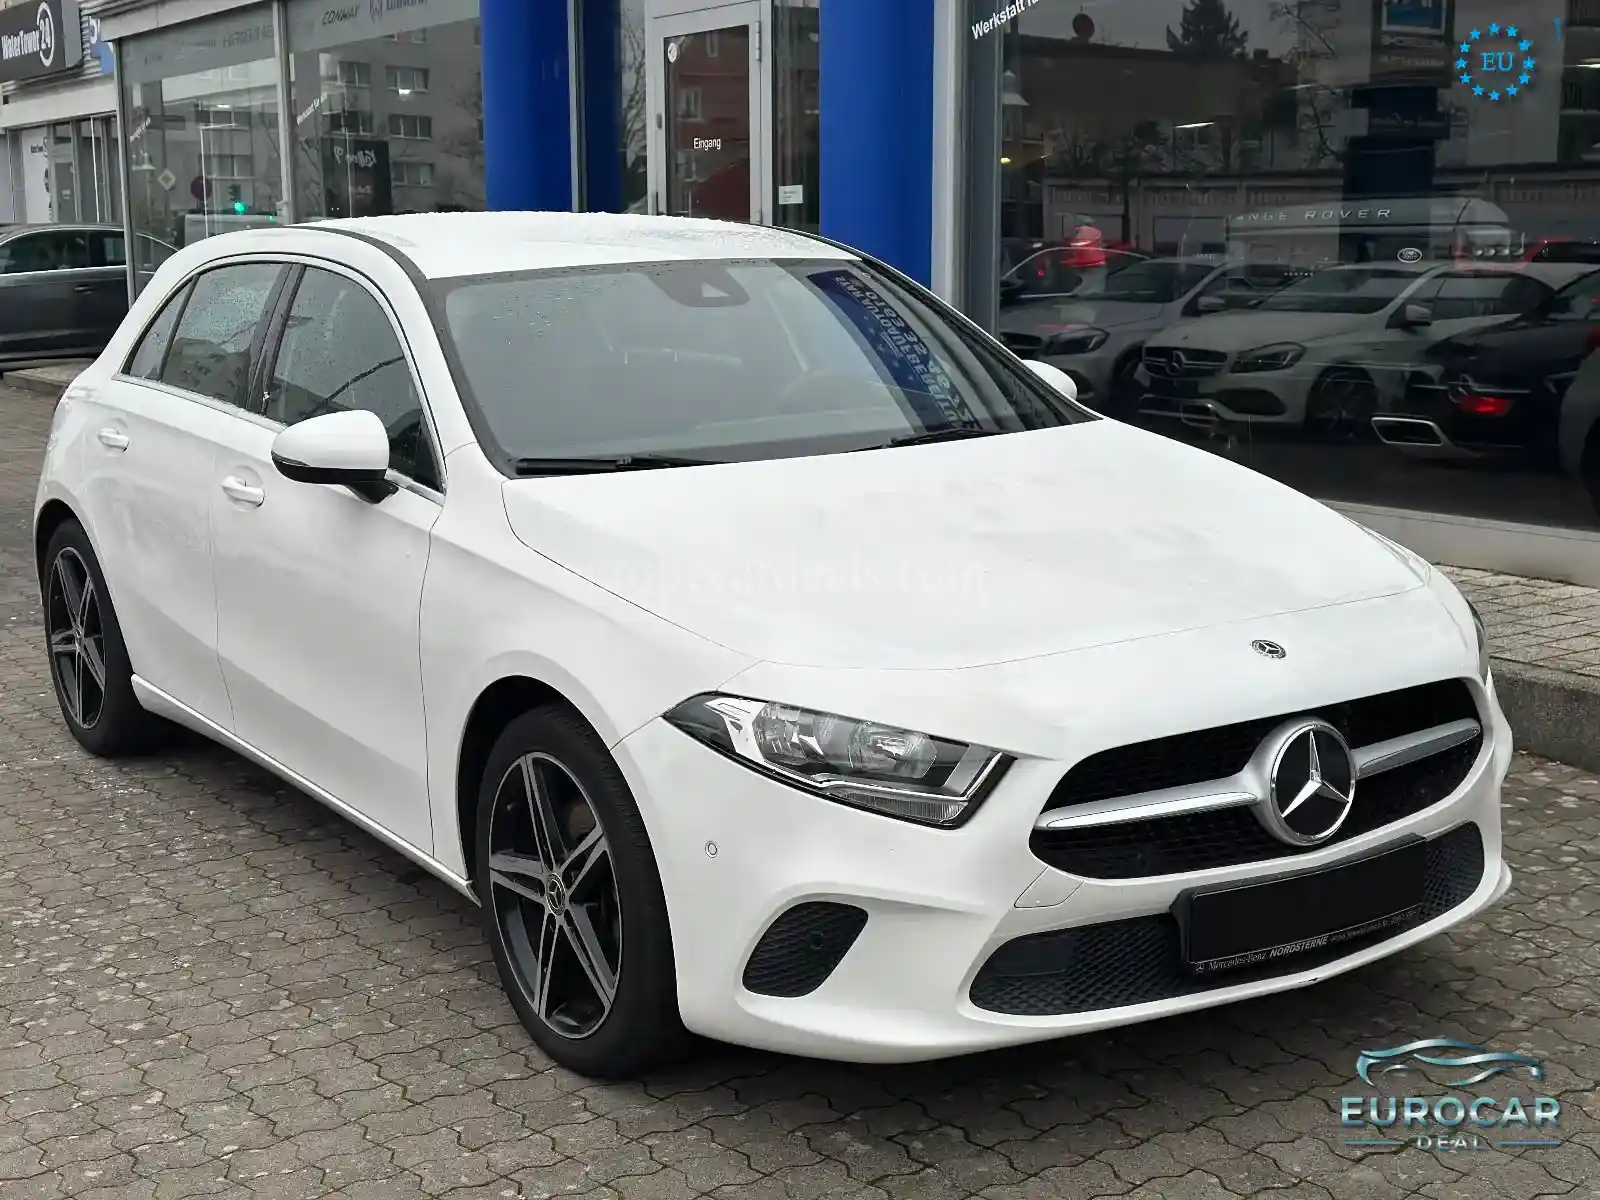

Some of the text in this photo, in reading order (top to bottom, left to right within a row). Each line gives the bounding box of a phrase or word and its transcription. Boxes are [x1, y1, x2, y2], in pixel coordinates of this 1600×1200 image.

[971, 0, 1026, 40] Werkstatt
[40, 17, 51, 50] 24
[693, 137, 721, 151] Eingang
[1304, 208, 1391, 220] ROVER
[1269, 936, 1329, 960] NORDSTERNE
